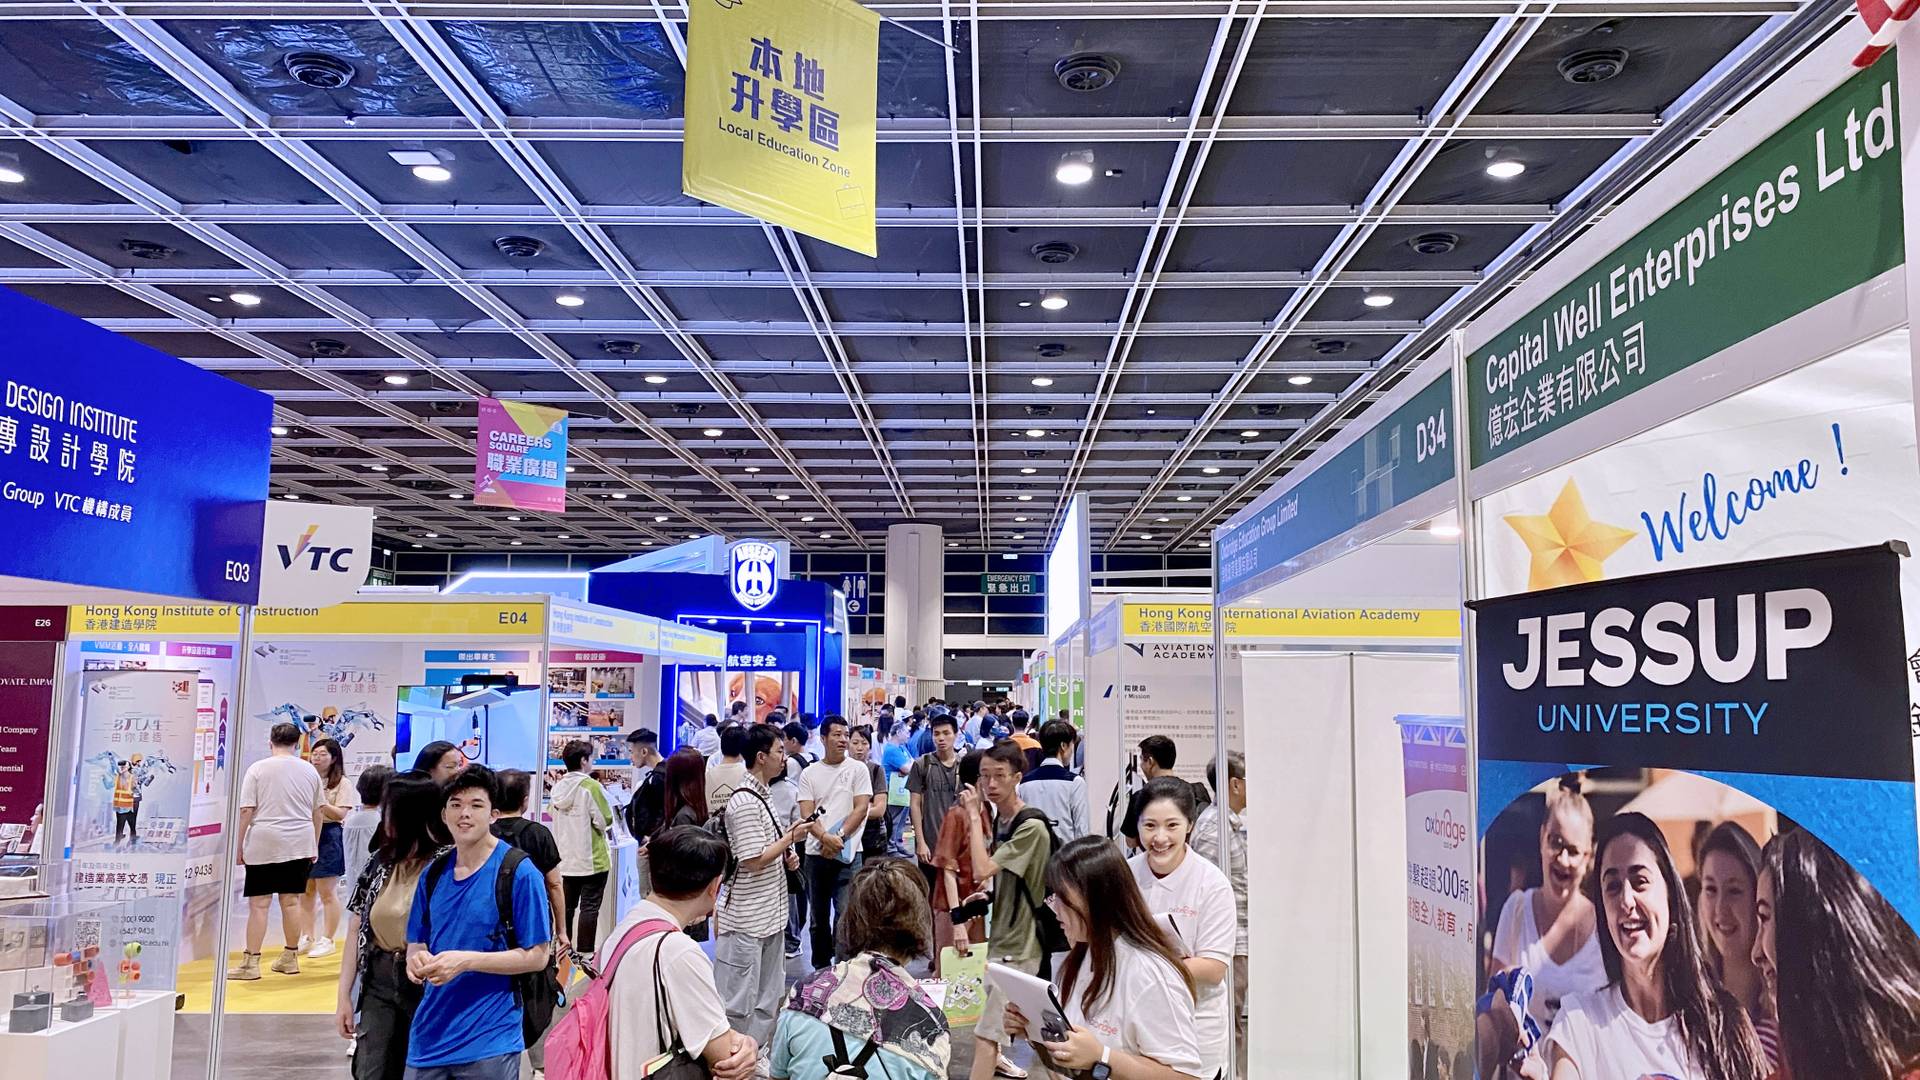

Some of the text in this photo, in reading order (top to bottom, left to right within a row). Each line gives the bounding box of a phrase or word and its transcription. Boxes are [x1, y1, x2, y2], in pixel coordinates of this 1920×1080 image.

[749, 37, 825, 101] 本地
[730, 71, 840, 152] 升學區
[718, 117, 851, 178] Local Education Zone
[1485, 81, 1895, 395] Capital Well Enterprises Ltd
[1486, 320, 1647, 450] 億宏企業有限公司
[5, 380, 138, 444] DESIGN INSTITUTE
[489, 430, 552, 449] CAREERS
[489, 441, 529, 454] SQUARE
[1416, 408, 1447, 463] D34
[486, 452, 558, 480] 職業廣場
[3, 481, 45, 510] Group
[54, 491, 81, 513] VTC
[1640, 422, 1849, 563] Welcome !
[277, 525, 353, 573] VTC
[225, 560, 250, 583] E03
[35, 619, 51, 627] E26
[85, 606, 119, 619] Hong
[124, 606, 158, 619] Kong
[162, 606, 214, 617] Institute
[218, 606, 231, 617] of
[85, 619, 157, 631] 香港建造學院
[499, 612, 527, 625] E04
[1139, 608, 1173, 620] Hong
[1178, 608, 1212, 620] Kong
[1302, 609, 1355, 620] Aviation
[1360, 609, 1420, 622] Academy
[1139, 622, 1237, 633] 香港國際航空院
[1502, 588, 1832, 690] JESSUP
[0, 678, 28, 686] OVATE.
[3, 727, 38, 735] Company
[1538, 702, 1768, 736] UNIVERSITY
[1425, 809, 1466, 849] oxbridge
[154, 873, 177, 885] 現正
